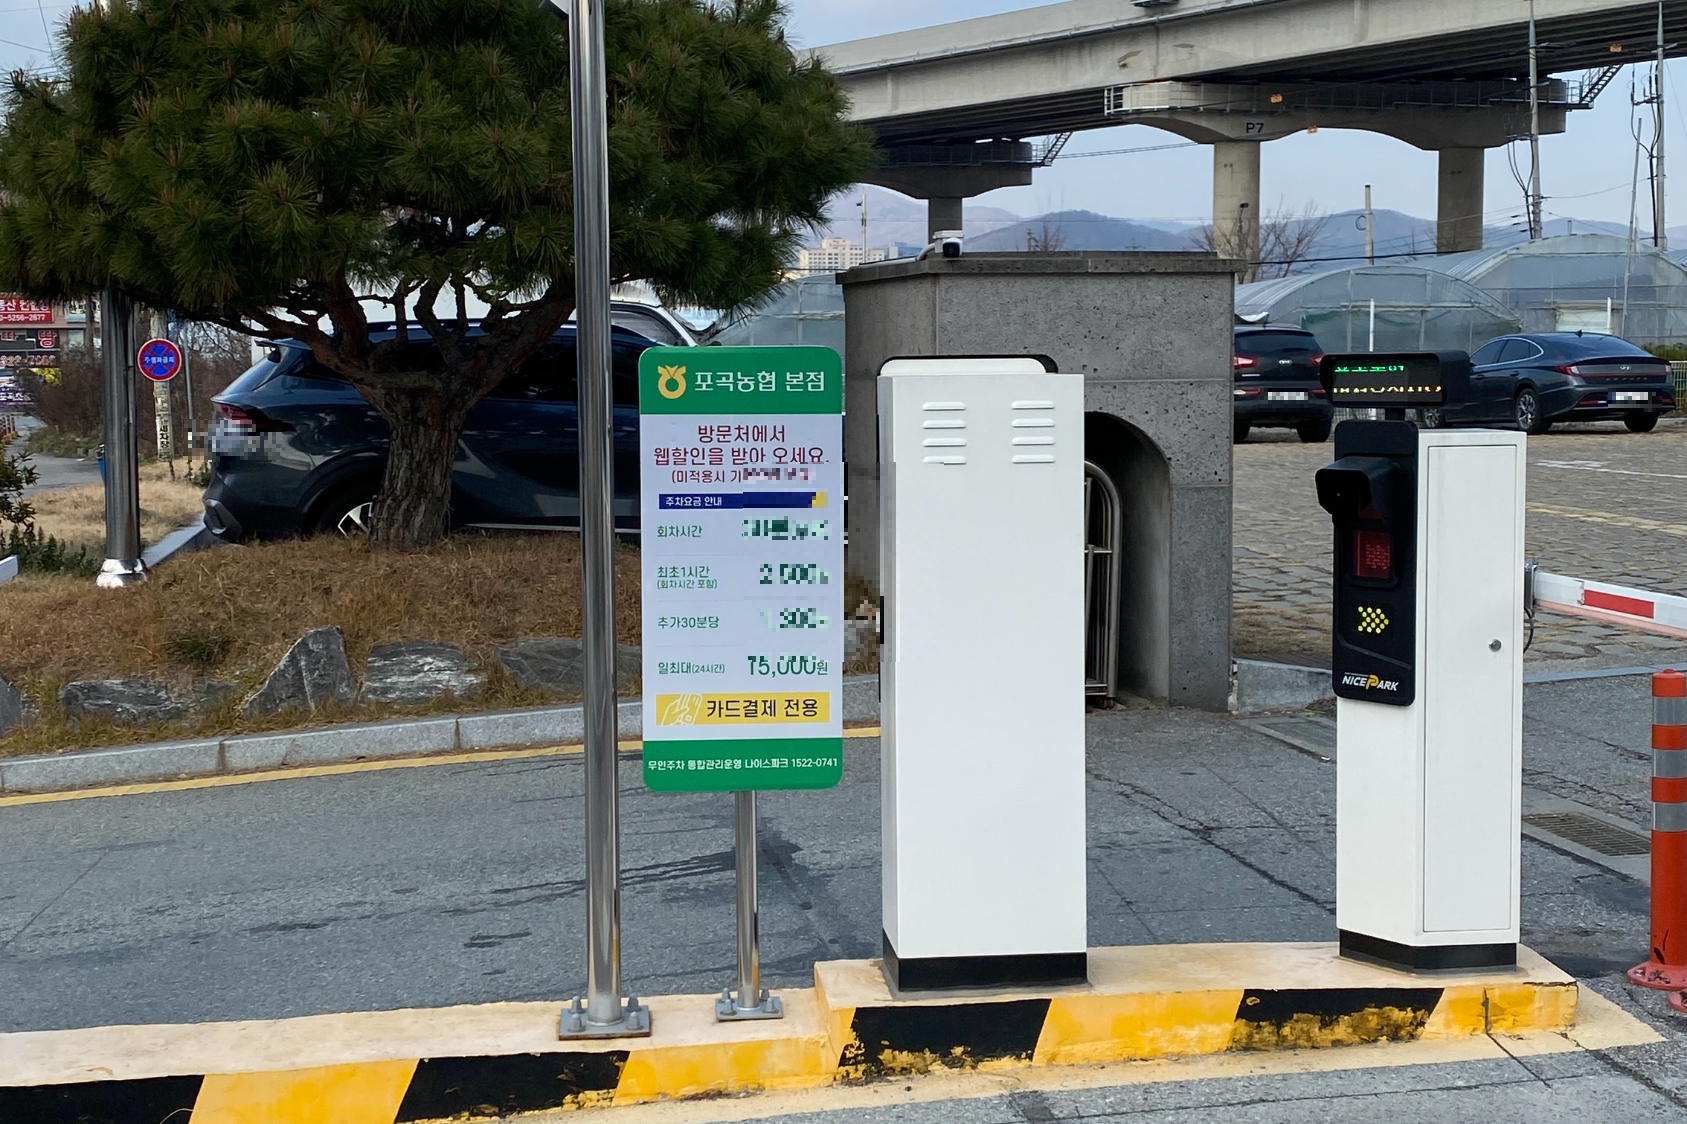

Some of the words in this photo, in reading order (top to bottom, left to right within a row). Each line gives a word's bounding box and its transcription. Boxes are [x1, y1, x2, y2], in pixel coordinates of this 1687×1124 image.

[1245, 122, 1264, 133] P7
[694, 371, 776, 392] 포곡농협
[785, 371, 825, 392] 본점
[698, 425, 785, 443] 방문처에서
[653, 447, 724, 466] 웹할인을
[731, 447, 766, 465] 받아
[773, 447, 830, 464] 오세요.
[671, 470, 725, 483] (미적용시
[665, 496, 701, 506] 주차요금
[704, 495, 722, 506] 안내
[657, 525, 703, 538] 회차시간
[657, 566, 710, 578] 최초1시간
[657, 579, 695, 589] (회차시간
[697, 579, 718, 589] 포함)
[658, 616, 720, 629] 추가30분당
[1341, 674, 1399, 691] NICEPARK
[707, 699, 776, 718] 카드결제
[784, 698, 818, 717] 전용
[648, 760, 685, 770] 무인주차
[687, 759, 742, 770] 통합관리운영
[745, 759, 788, 769] 나이스파크
[791, 758, 838, 768] 1522-0741
